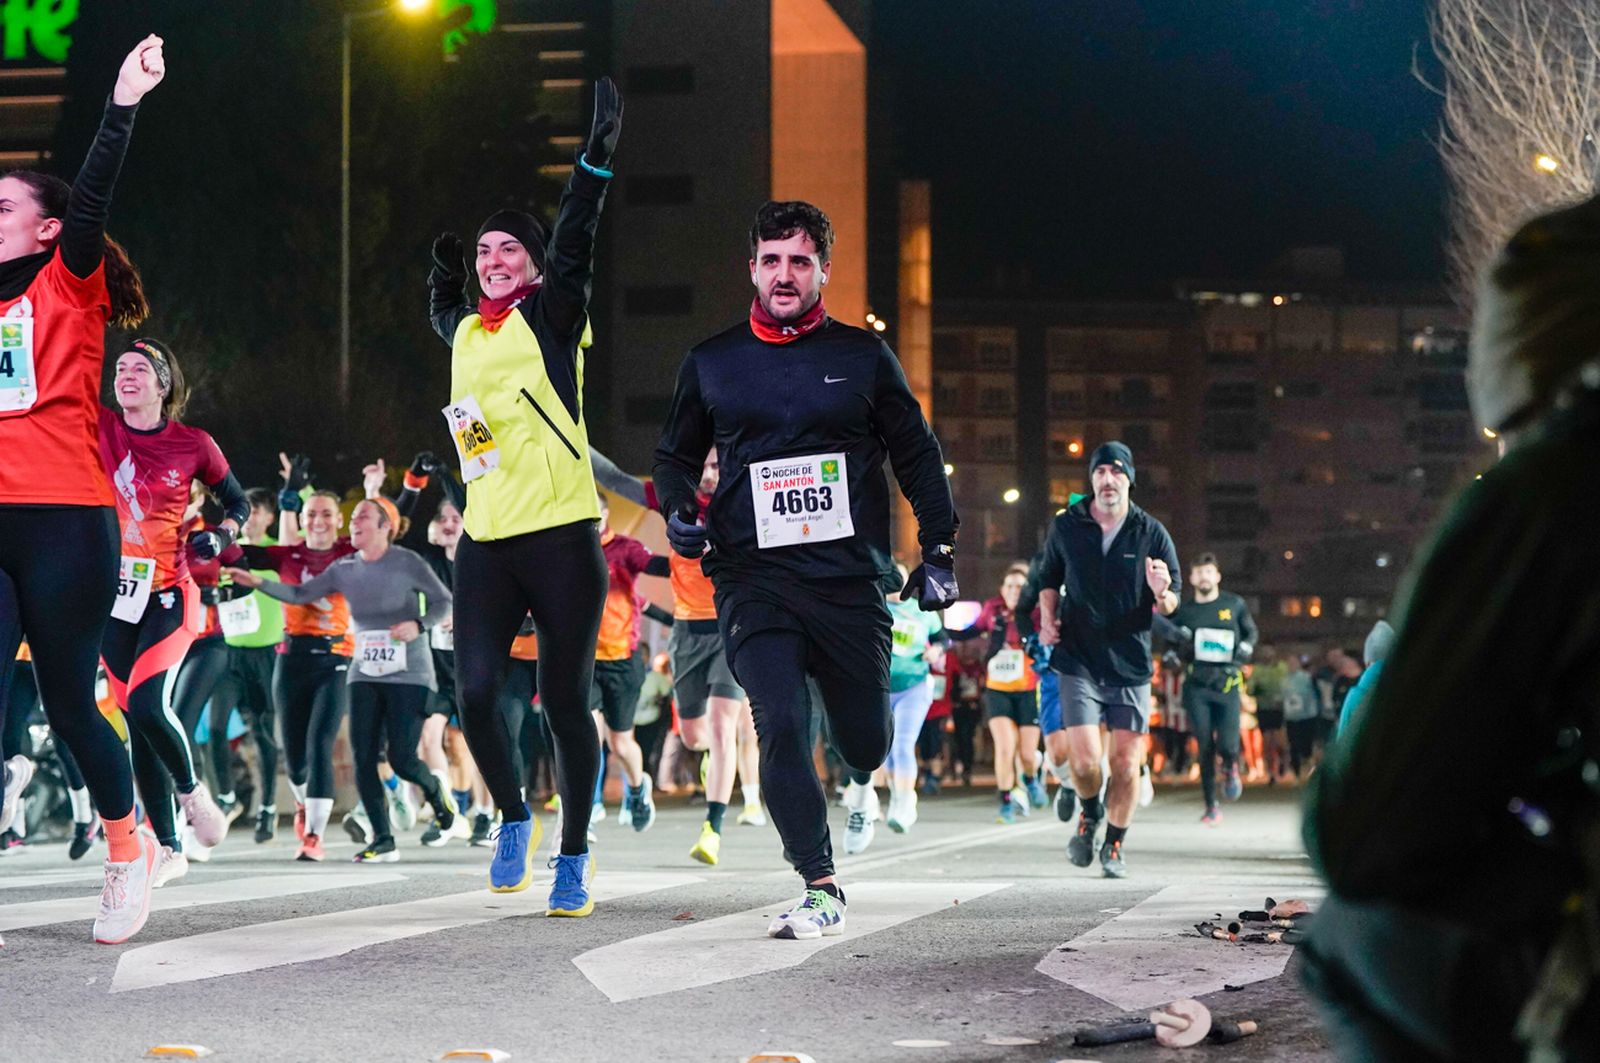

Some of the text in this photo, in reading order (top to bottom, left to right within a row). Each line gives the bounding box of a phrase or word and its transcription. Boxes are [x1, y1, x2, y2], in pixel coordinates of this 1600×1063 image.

[0, 351, 15, 377] 4
[772, 467, 800, 478] NOCHE
[802, 466, 813, 475] DE
[763, 480, 781, 491] SAN
[772, 486, 833, 516] 4663
[786, 515, 807, 523] Manuel
[117, 579, 138, 598] 57
[363, 648, 395, 661] 5242
